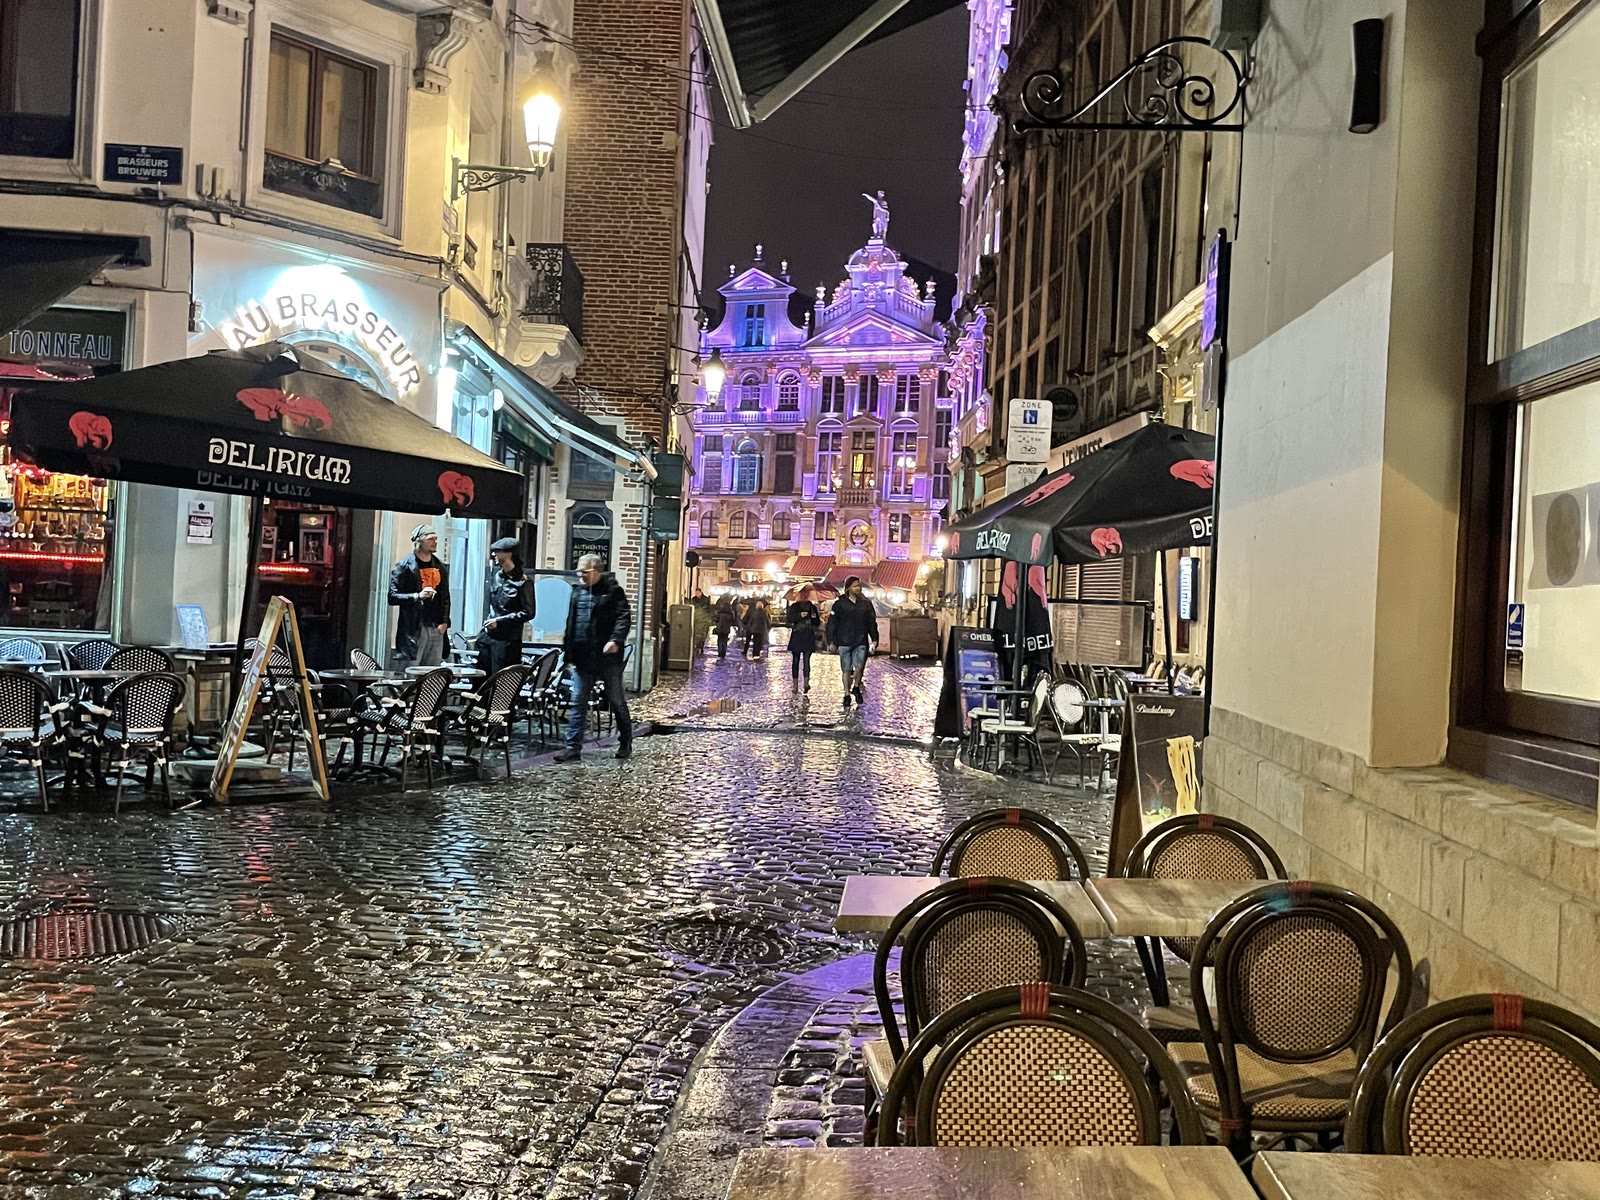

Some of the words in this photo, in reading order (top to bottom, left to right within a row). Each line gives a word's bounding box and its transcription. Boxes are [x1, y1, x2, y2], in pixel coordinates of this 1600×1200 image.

[117, 157, 169, 168] BRASSEURS
[117, 166, 168, 177] BROUWERS
[9, 329, 112, 360] TONNEAU
[232, 305, 270, 349] AU
[276, 294, 421, 391] BRASSEUR
[208, 437, 351, 484] DELIRIUM
